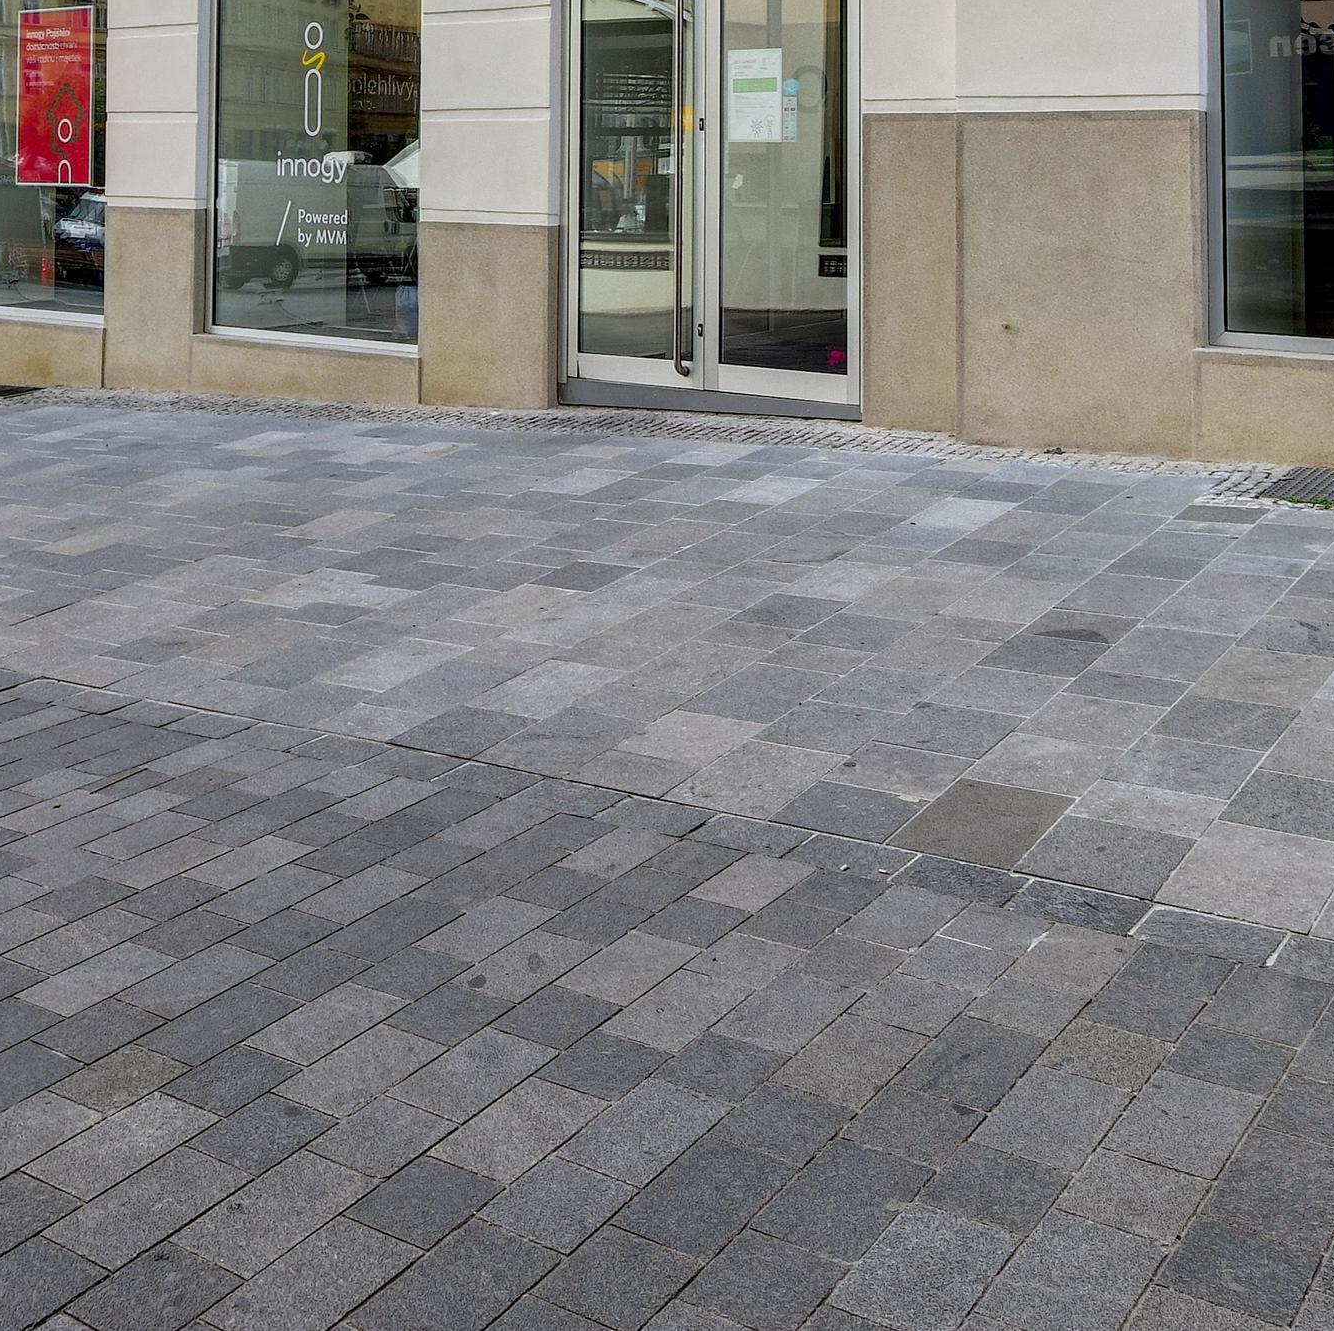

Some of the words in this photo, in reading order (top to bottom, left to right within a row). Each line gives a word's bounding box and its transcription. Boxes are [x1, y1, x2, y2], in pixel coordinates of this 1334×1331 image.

[276, 151, 348, 184] innogy
[298, 208, 348, 225] Powered
[298, 228, 312, 247] by
[316, 230, 347, 245] MVM
